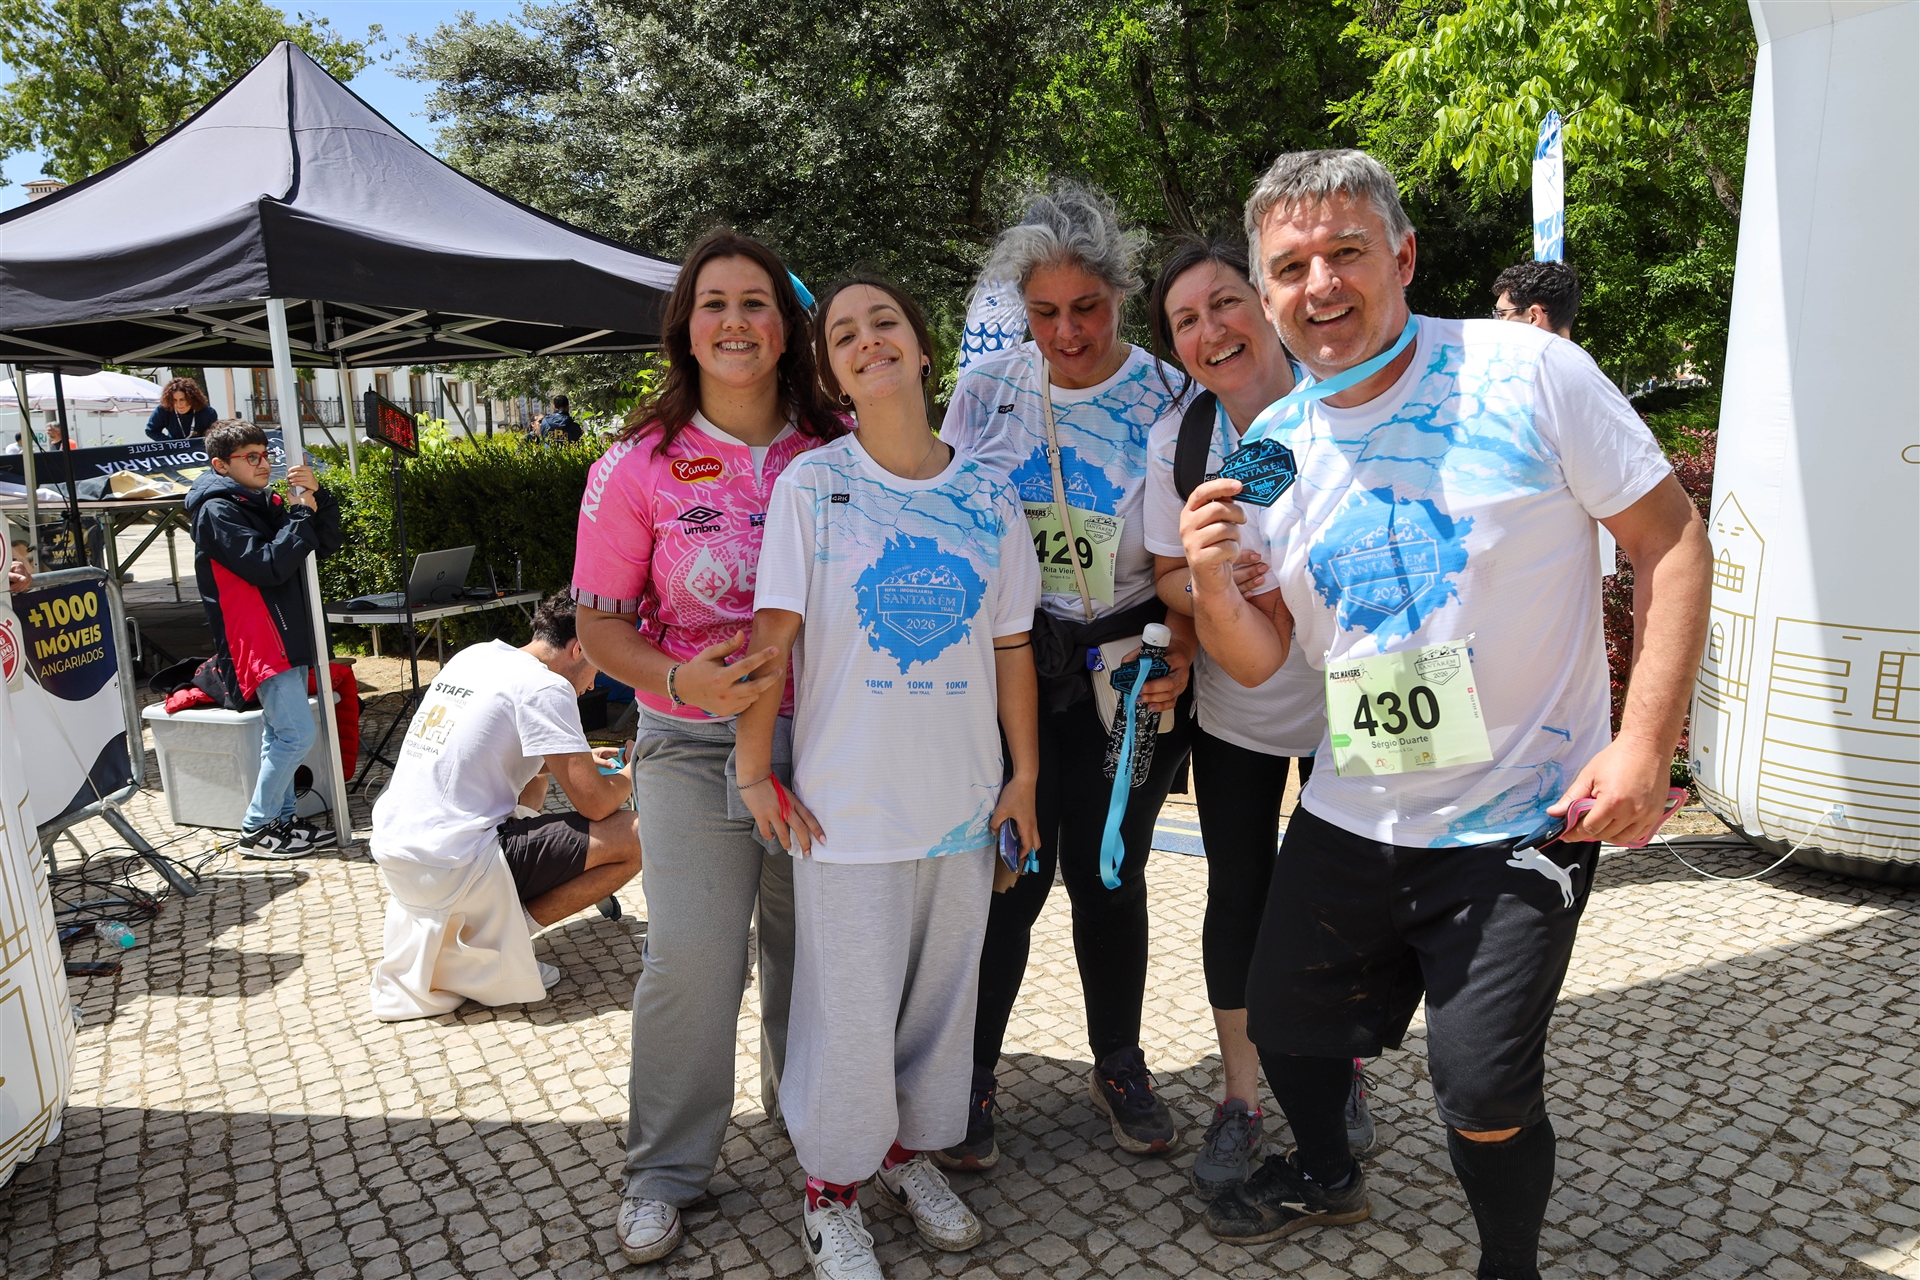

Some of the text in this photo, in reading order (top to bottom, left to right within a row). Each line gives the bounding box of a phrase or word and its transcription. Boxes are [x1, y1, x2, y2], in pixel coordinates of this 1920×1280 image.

[128, 441, 191, 454] REAL ESTATE
[95, 451, 209, 475] OBILIÁRIA
[675, 461, 720, 479] Canção
[1250, 480, 1276, 492] Finisher
[684, 524, 721, 535] umbro
[1034, 530, 1093, 569] 429
[1340, 552, 1428, 578] SANTARÉM
[883, 593, 956, 607] SANTARÉM
[1373, 584, 1408, 600] 2026
[28, 591, 98, 628] +1000
[906, 618, 936, 630] 2026
[34, 624, 102, 660] IMÓVEIS
[40, 647, 104, 678] ANGARIADOS
[435, 682, 474, 698] STAFF
[865, 679, 893, 689] 18KM
[907, 681, 933, 689] 10KM
[945, 681, 968, 689] 10KM
[1353, 686, 1440, 737] 430
[1371, 735, 1429, 749] Sérgio Duarte
